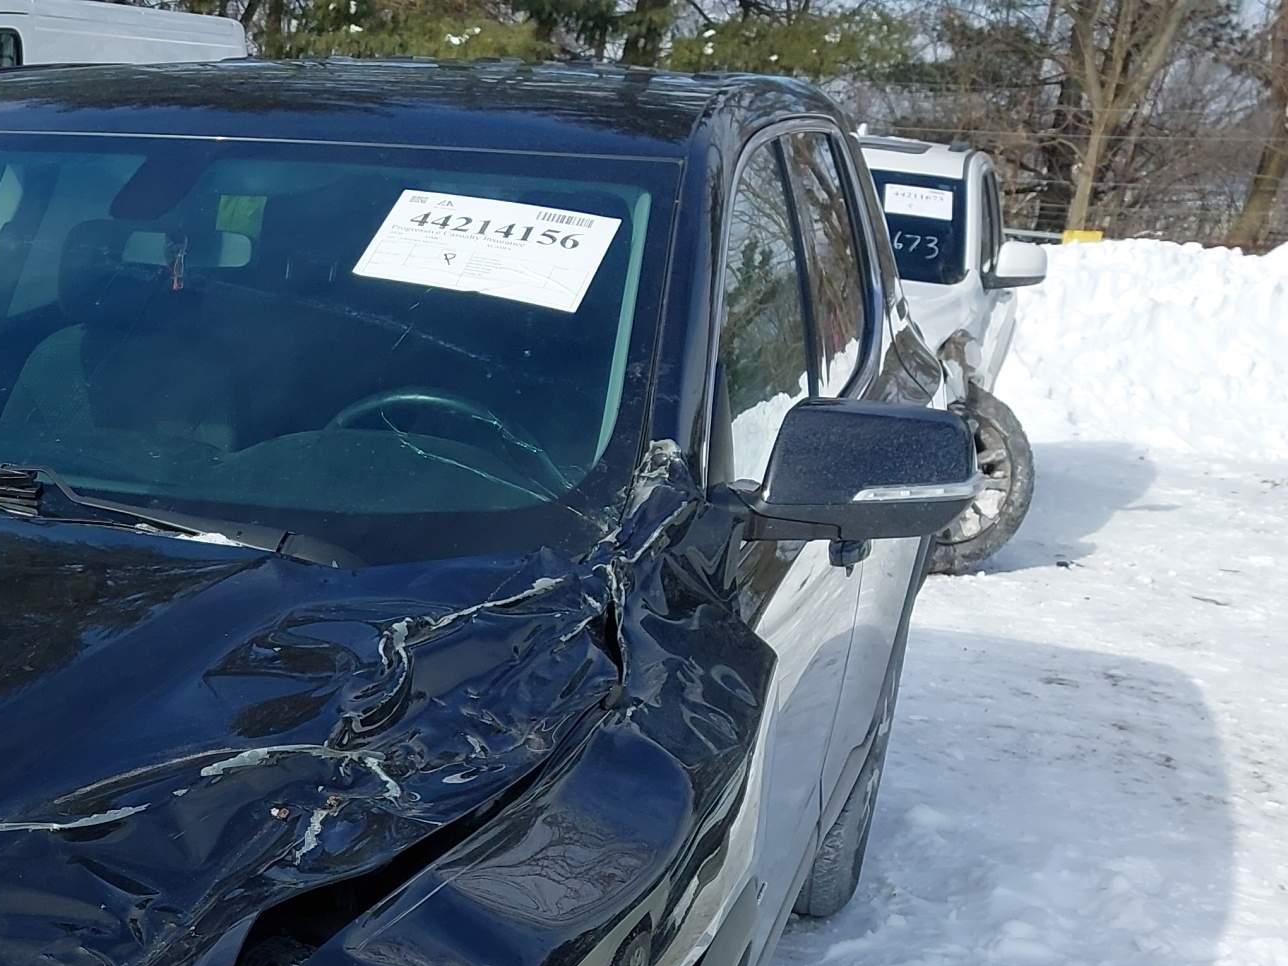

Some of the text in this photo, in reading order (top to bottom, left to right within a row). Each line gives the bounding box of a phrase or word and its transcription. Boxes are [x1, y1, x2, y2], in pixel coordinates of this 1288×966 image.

[391, 224, 441, 236] Progressive
[443, 229, 480, 241] Casualty
[482, 235, 526, 248] Insurance
[410, 211, 584, 249] 44214156
[893, 230, 940, 260] 673
